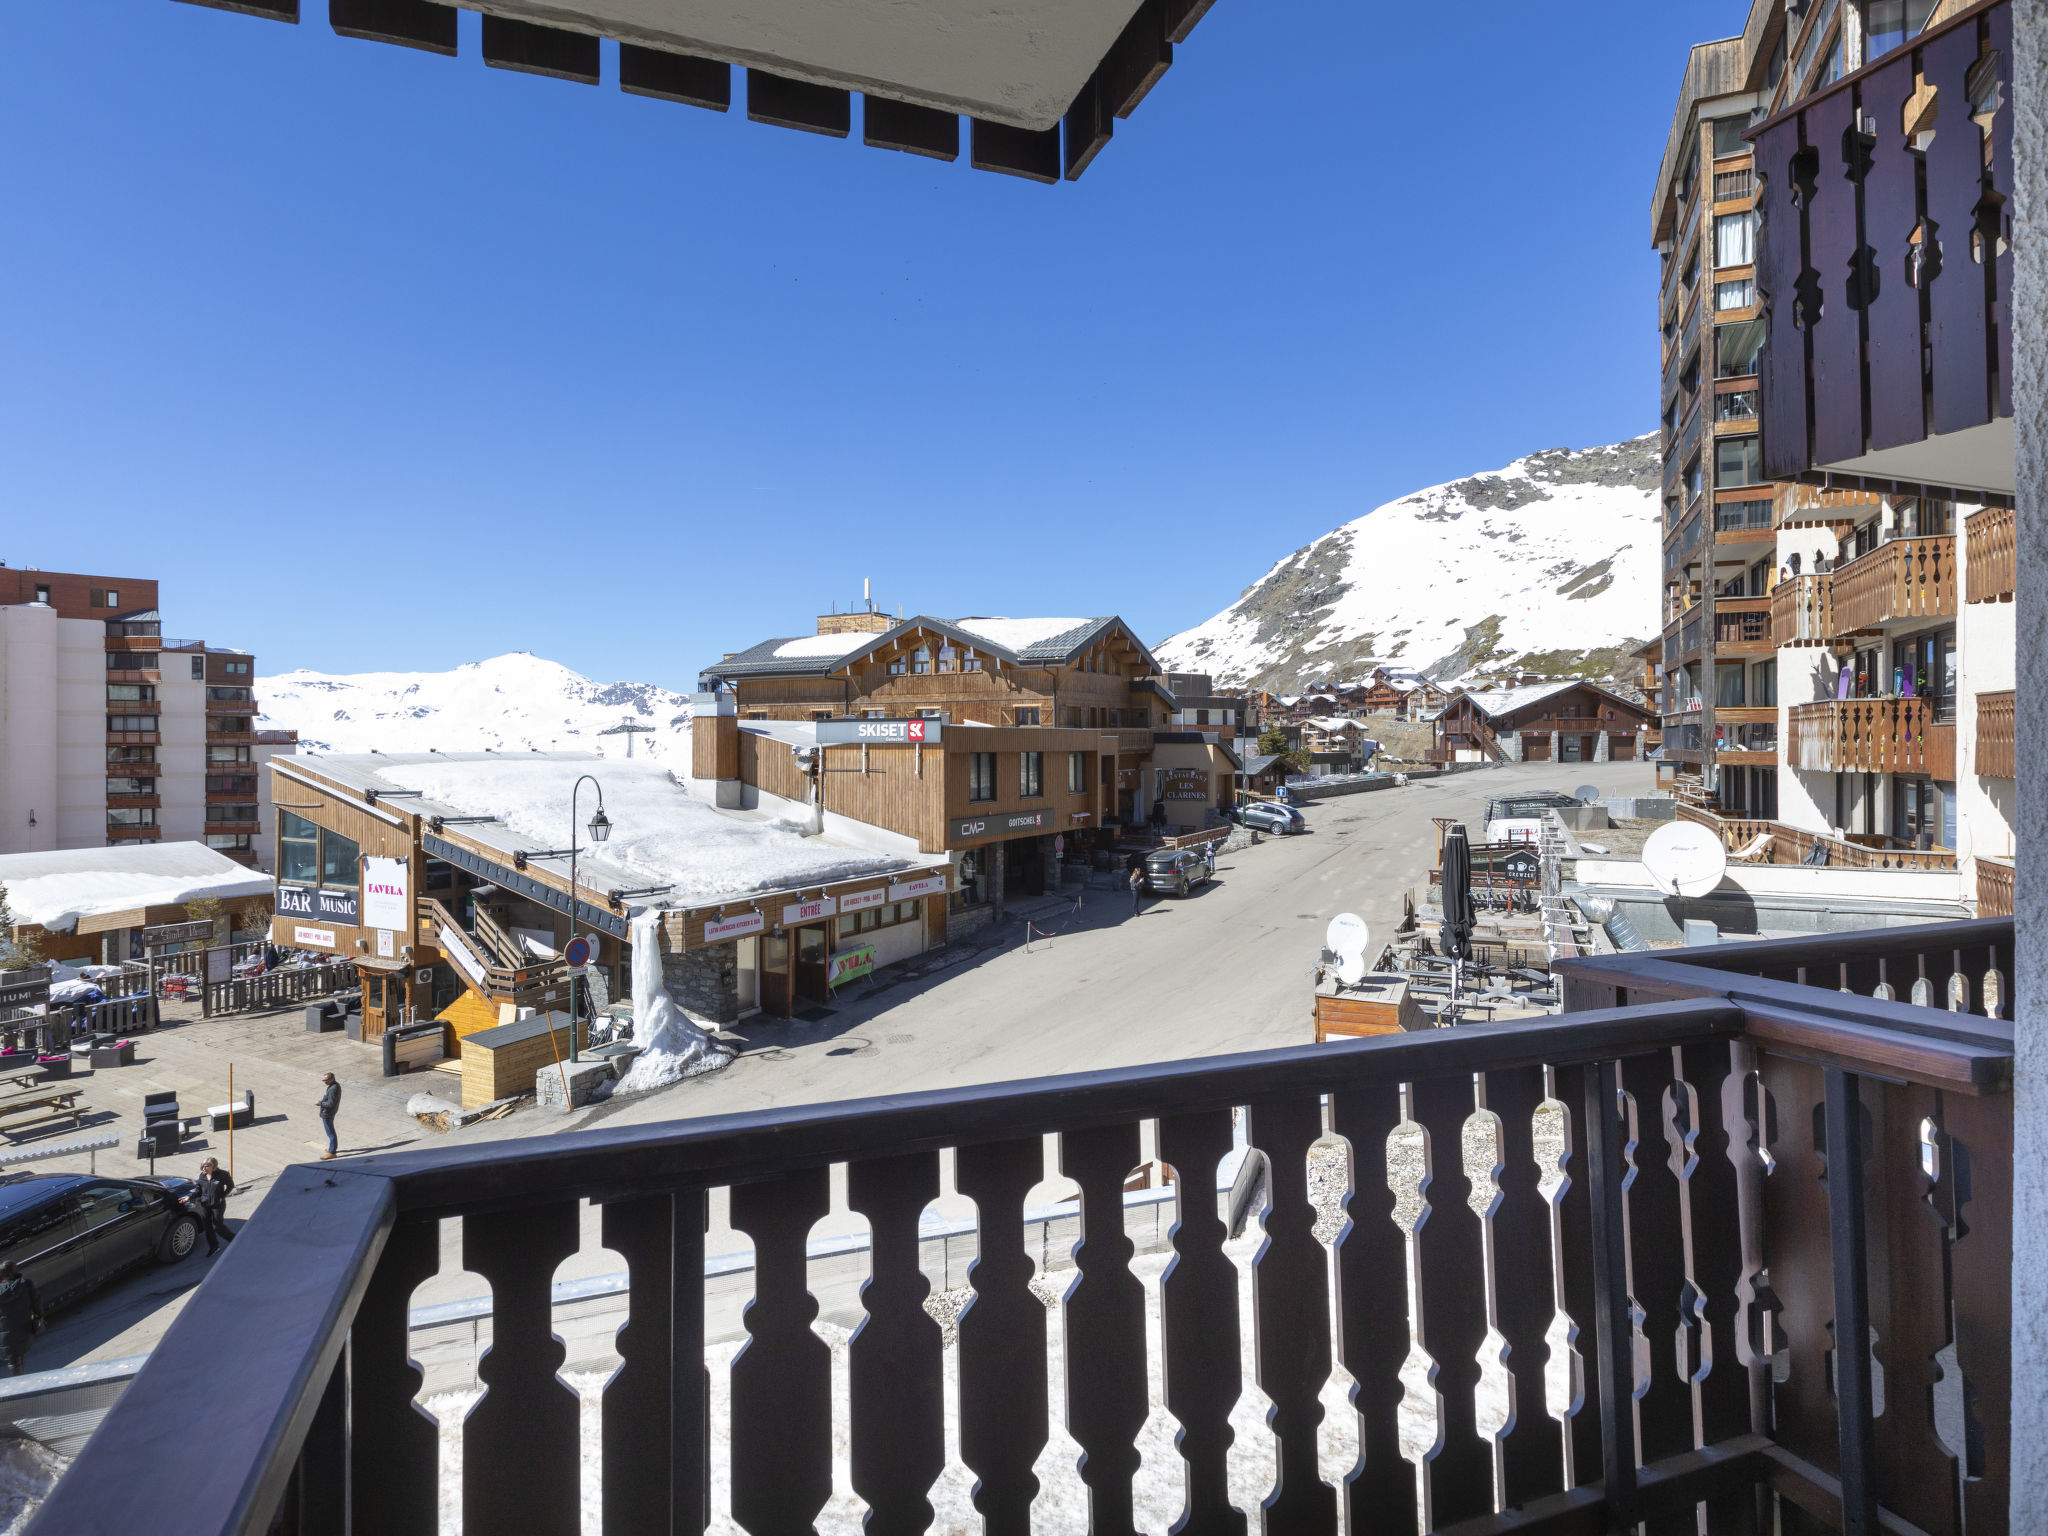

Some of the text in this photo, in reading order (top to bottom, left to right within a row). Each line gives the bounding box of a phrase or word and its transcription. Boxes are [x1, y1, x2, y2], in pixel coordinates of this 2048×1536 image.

[858, 723, 906, 737] SKISET
[1167, 791, 1206, 799] CLARINES
[961, 821, 985, 835] CMP
[1008, 816, 1035, 828] GOITSCHEL
[368, 883, 404, 896] FAVELA
[909, 882, 929, 891] FAVELA
[280, 890, 312, 912] BAR
[320, 897, 356, 915] MUSIC
[800, 902, 821, 918] ENTRÉE
[708, 926, 719, 934] LATIN
[719, 923, 736, 932] AMERICAN
[736, 920, 750, 929] KITCHEN
[0, 991, 28, 1003] IUM
